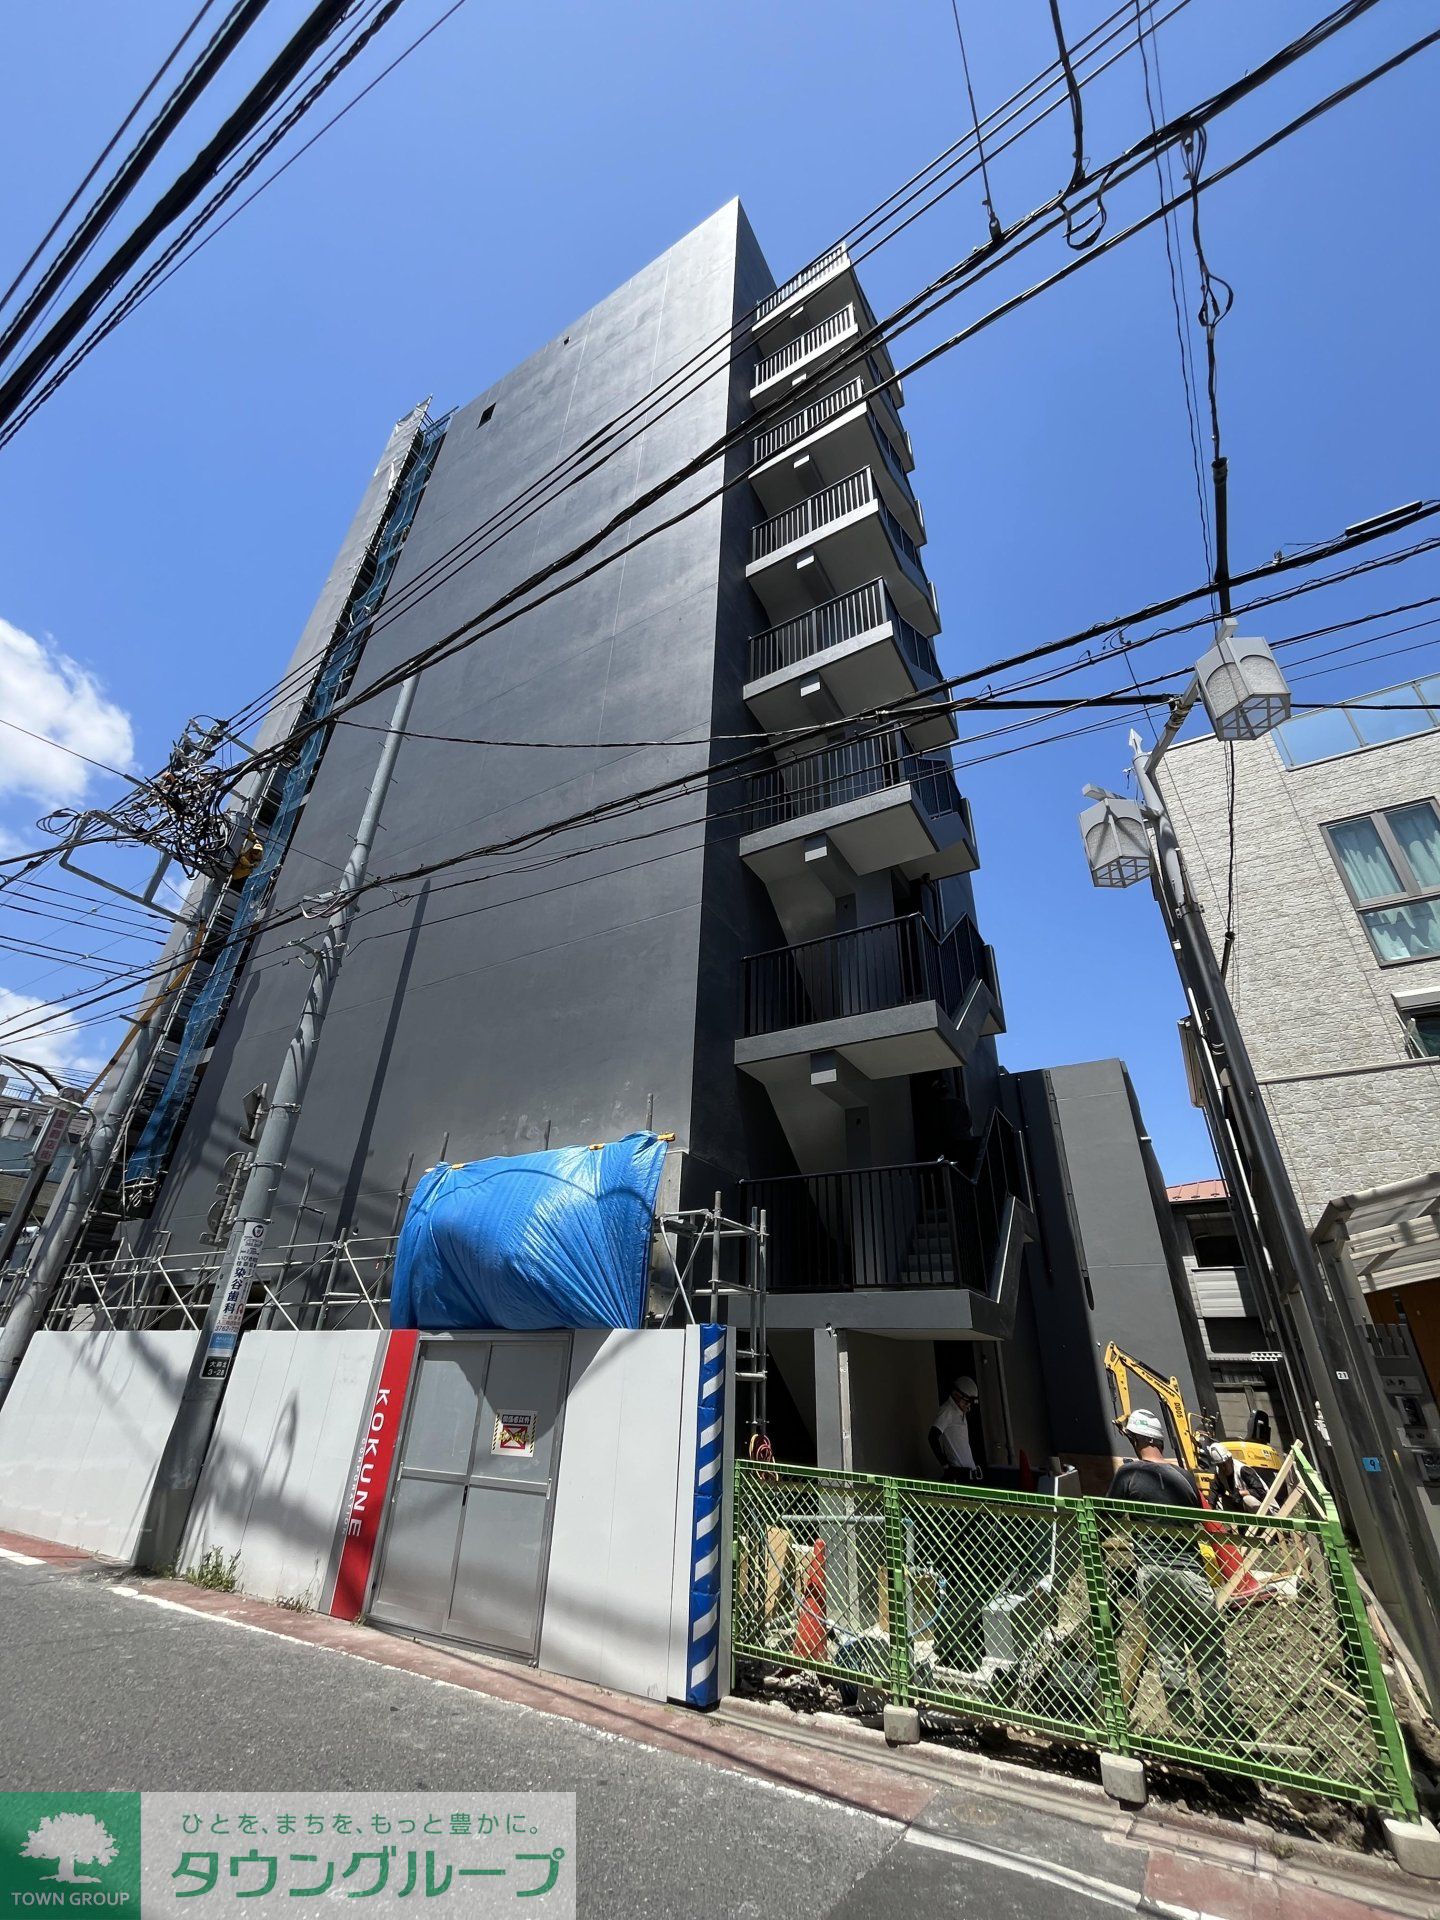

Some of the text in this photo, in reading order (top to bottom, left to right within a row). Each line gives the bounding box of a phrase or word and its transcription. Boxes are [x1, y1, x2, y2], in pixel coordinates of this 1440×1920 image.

[223, 1267, 246, 1314] 染谷歯科
[348, 1389, 391, 1537] KOKUNE
